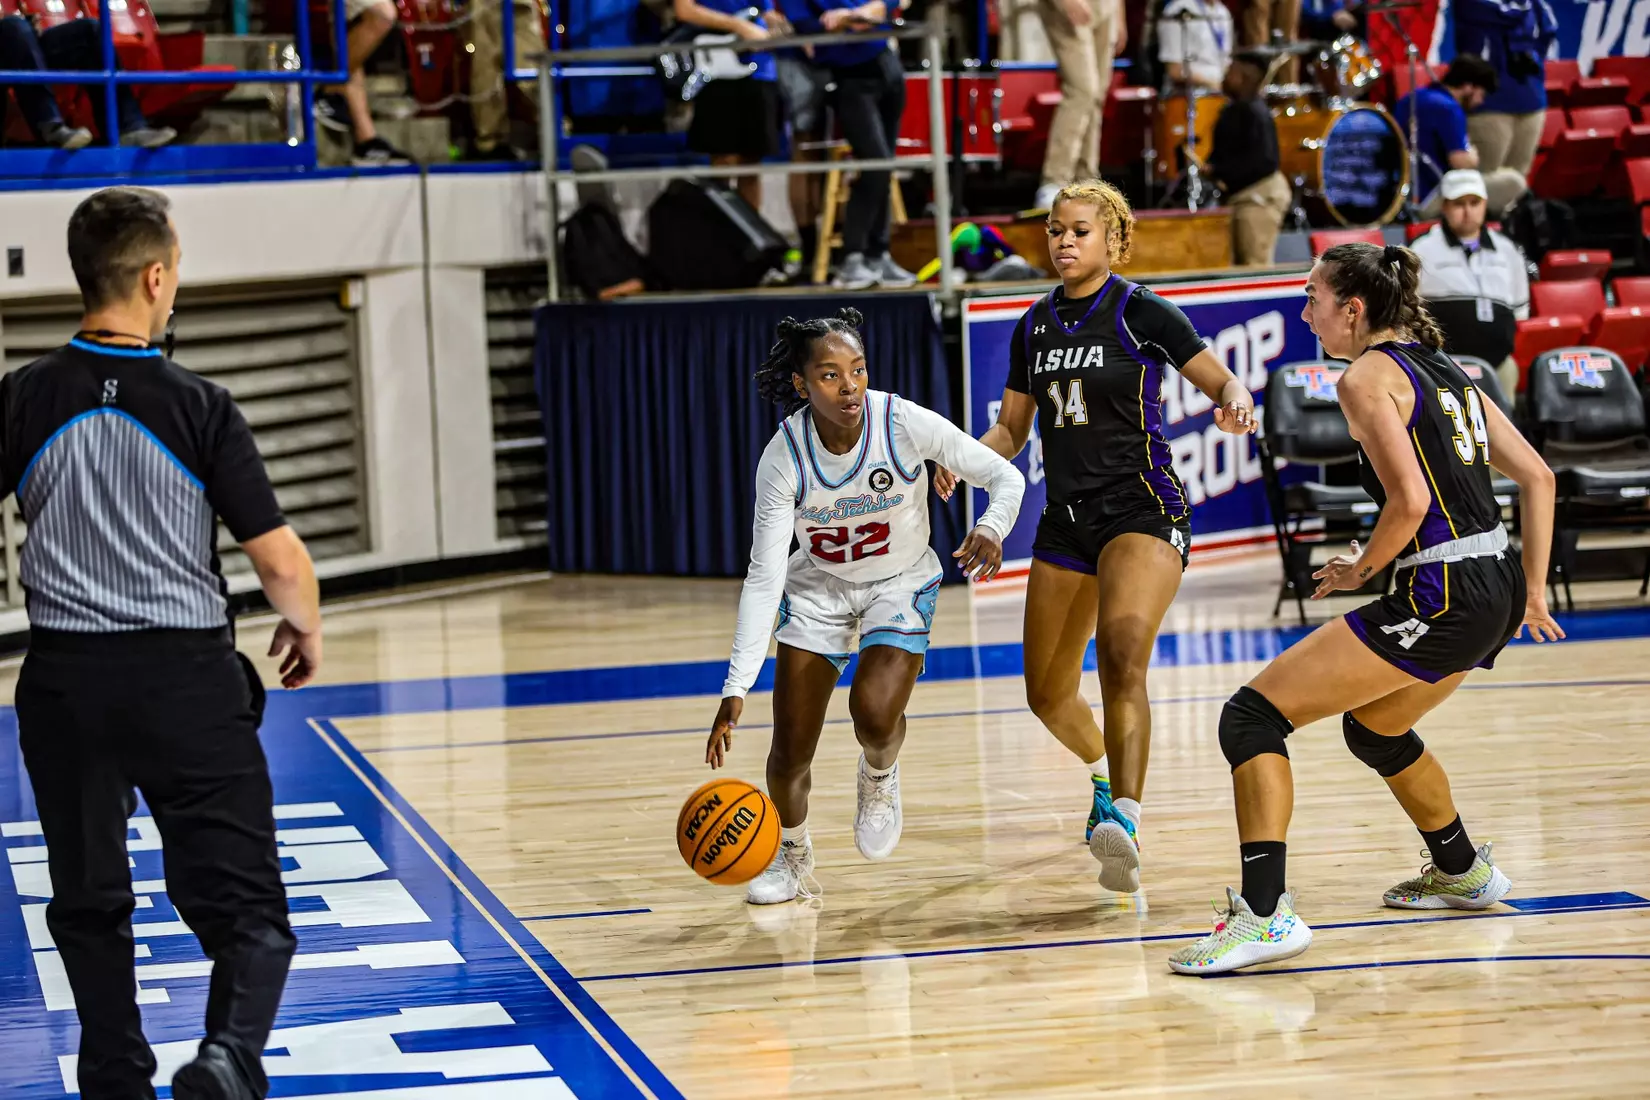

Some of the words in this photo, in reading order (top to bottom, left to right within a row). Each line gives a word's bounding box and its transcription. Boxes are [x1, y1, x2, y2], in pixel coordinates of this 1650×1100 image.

[1034, 345, 1104, 375] LSUA
[1047, 379, 1088, 427] 14
[1437, 386, 1489, 465] 34
[806, 521, 890, 563] 22
[684, 794, 723, 840] NCAA
[700, 806, 757, 865] Wilson
